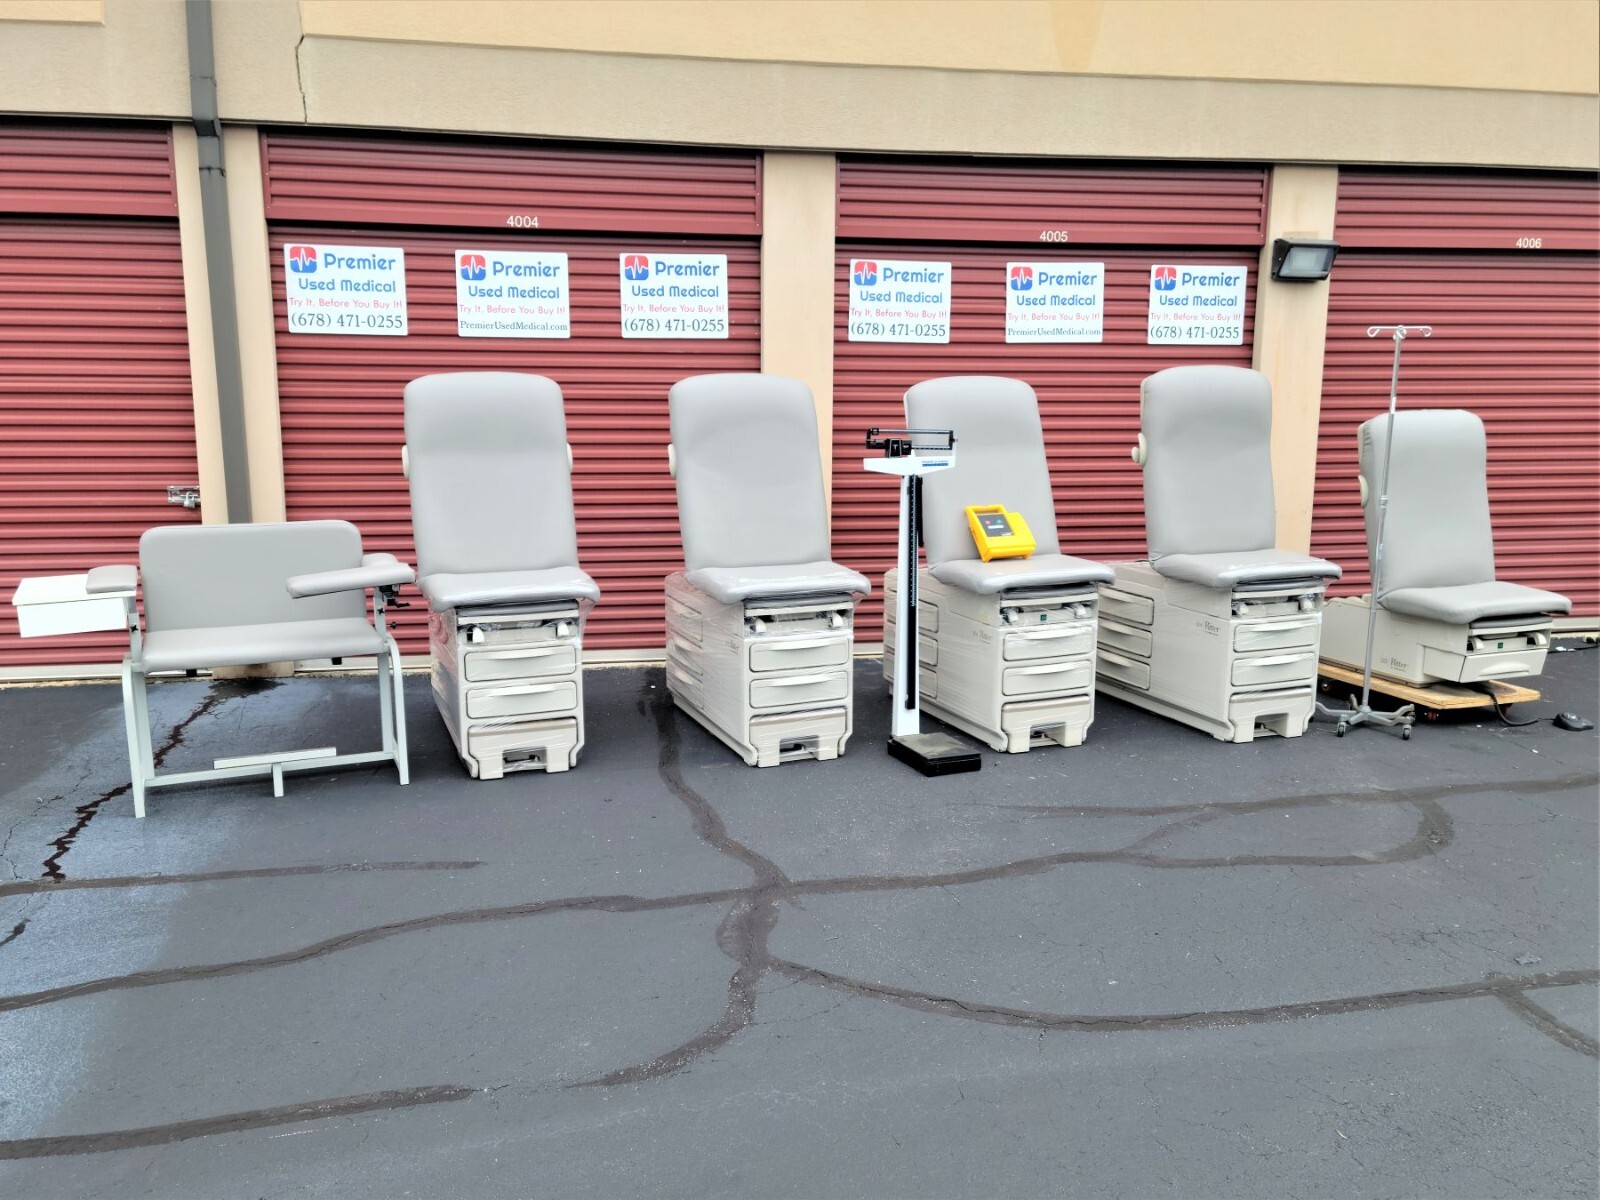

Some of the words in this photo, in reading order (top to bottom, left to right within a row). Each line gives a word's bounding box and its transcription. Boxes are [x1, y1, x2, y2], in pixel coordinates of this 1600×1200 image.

[506, 215, 539, 228] 4004
[1039, 230, 1068, 242] 4005
[1516, 237, 1542, 248] 4006
[324, 253, 395, 270] Premier
[493, 261, 560, 277] Premier
[655, 261, 719, 276] Premier
[883, 268, 944, 283] Premier
[1039, 271, 1097, 285] Premier
[1182, 272, 1240, 286] Premier
[299, 278, 335, 290] Used
[341, 280, 395, 292] Medical
[469, 286, 502, 297] Used
[508, 287, 559, 299] Medical
[632, 286, 664, 296] Used
[669, 286, 718, 297] Medical
[860, 291, 891, 302] Used
[896, 292, 942, 303] Medical
[289, 298, 302, 307] Try
[319, 298, 349, 307] Before
[353, 300, 370, 308] You
[374, 300, 389, 310] Buy
[1017, 295, 1046, 305] Used
[1051, 295, 1095, 305] Medical
[1160, 295, 1188, 306] Used
[1193, 296, 1237, 306] Medical
[460, 305, 472, 314] Try
[487, 305, 516, 313] Before
[519, 306, 534, 314] You
[538, 306, 553, 316] Buy
[623, 304, 634, 313] Try
[649, 304, 677, 312] Before
[680, 305, 695, 313] You
[699, 305, 713, 314] Buy
[851, 308, 862, 317] Try
[876, 309, 901, 317] Before
[922, 311, 936, 319] Buy
[292, 313, 331, 327] (678)
[337, 314, 402, 328] 471-0255
[1008, 313, 1018, 322] Try
[1076, 313, 1090, 322] Buy
[1151, 313, 1160, 322] Try
[1174, 313, 1198, 321] Before
[1218, 314, 1231, 322] Buy
[460, 321, 568, 330] PremierUsedMedical.com
[625, 319, 660, 331] (678)
[665, 319, 724, 331] 471-0255
[851, 322, 885, 335] (678)
[889, 324, 945, 336] 471-0255
[1151, 326, 1182, 338] (678)
[1187, 327, 1239, 338] 471-0255
